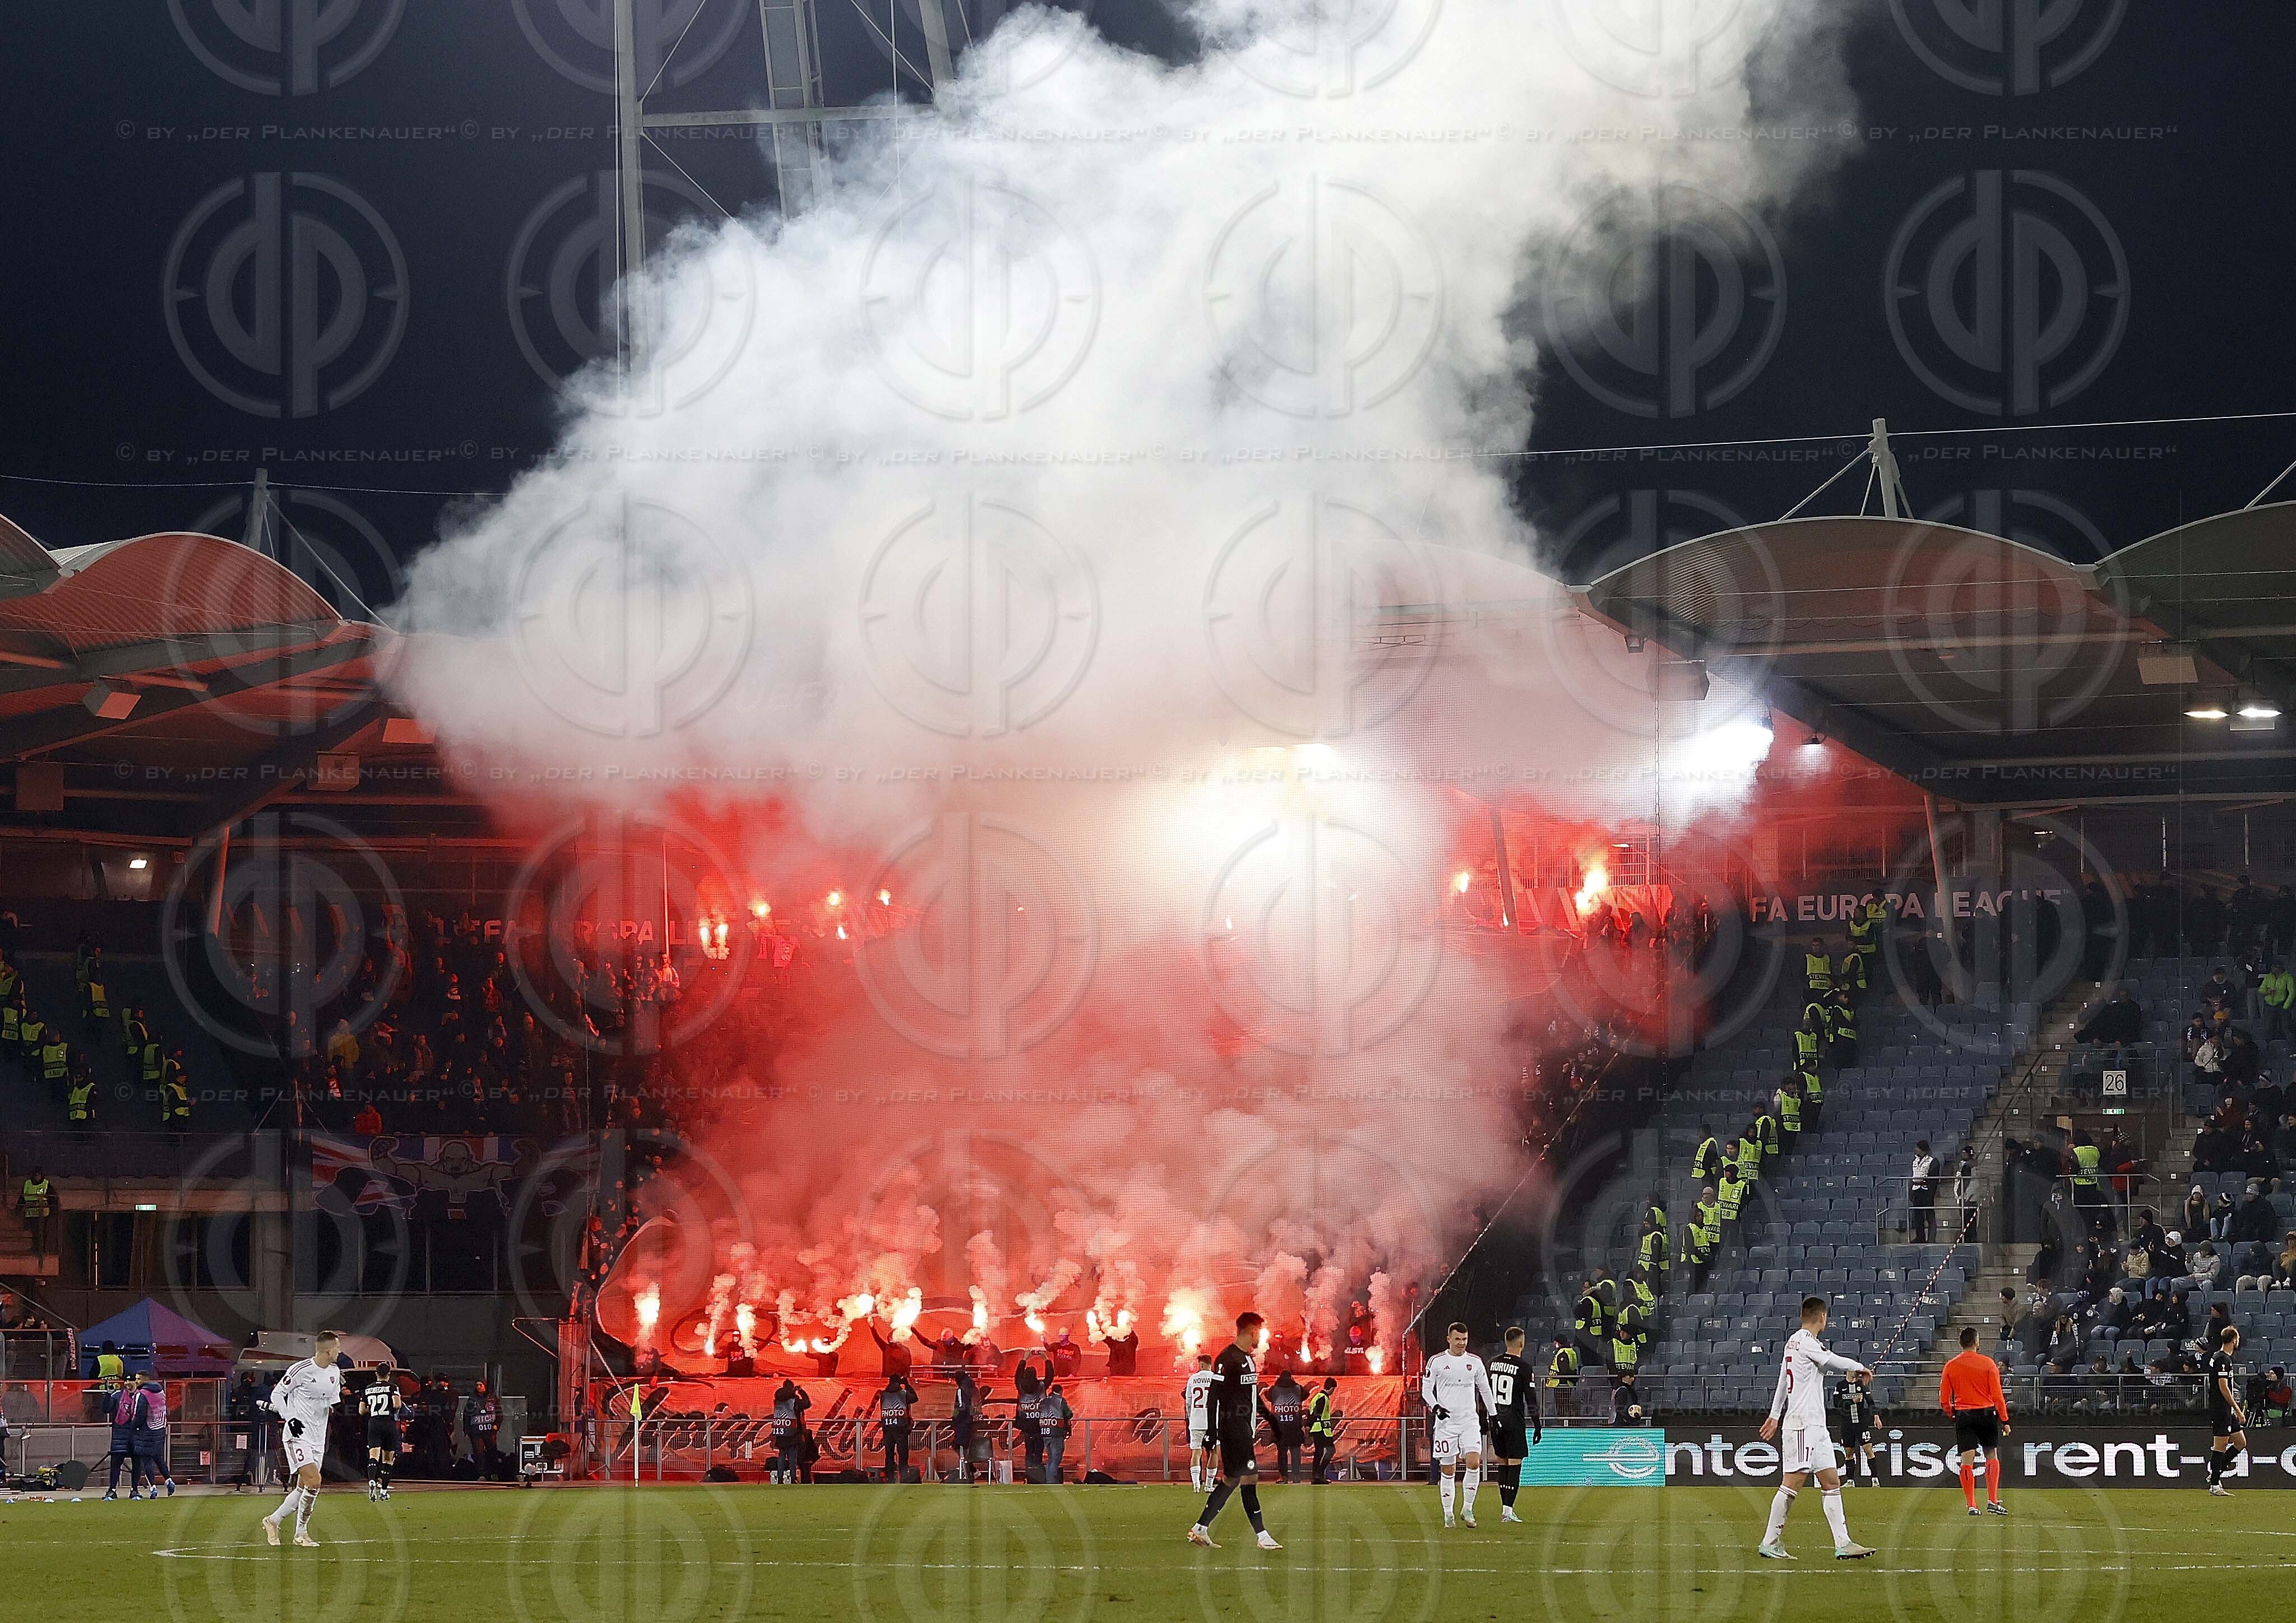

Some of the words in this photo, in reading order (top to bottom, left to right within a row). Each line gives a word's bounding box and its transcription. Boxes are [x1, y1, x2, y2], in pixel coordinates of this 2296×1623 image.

[2105, 1074, 2124, 1091] 26
[1490, 1362, 1519, 1375] HORVAT
[1490, 1374, 1513, 1405] 19
[367, 1394, 390, 1417] 22
[474, 1413, 496, 1423] PITCH
[882, 1409, 904, 1417] PHOTO
[1862, 1431, 1871, 1440] 42
[1435, 1440, 1449, 1453] 30
[295, 1448, 304, 1462] 3
